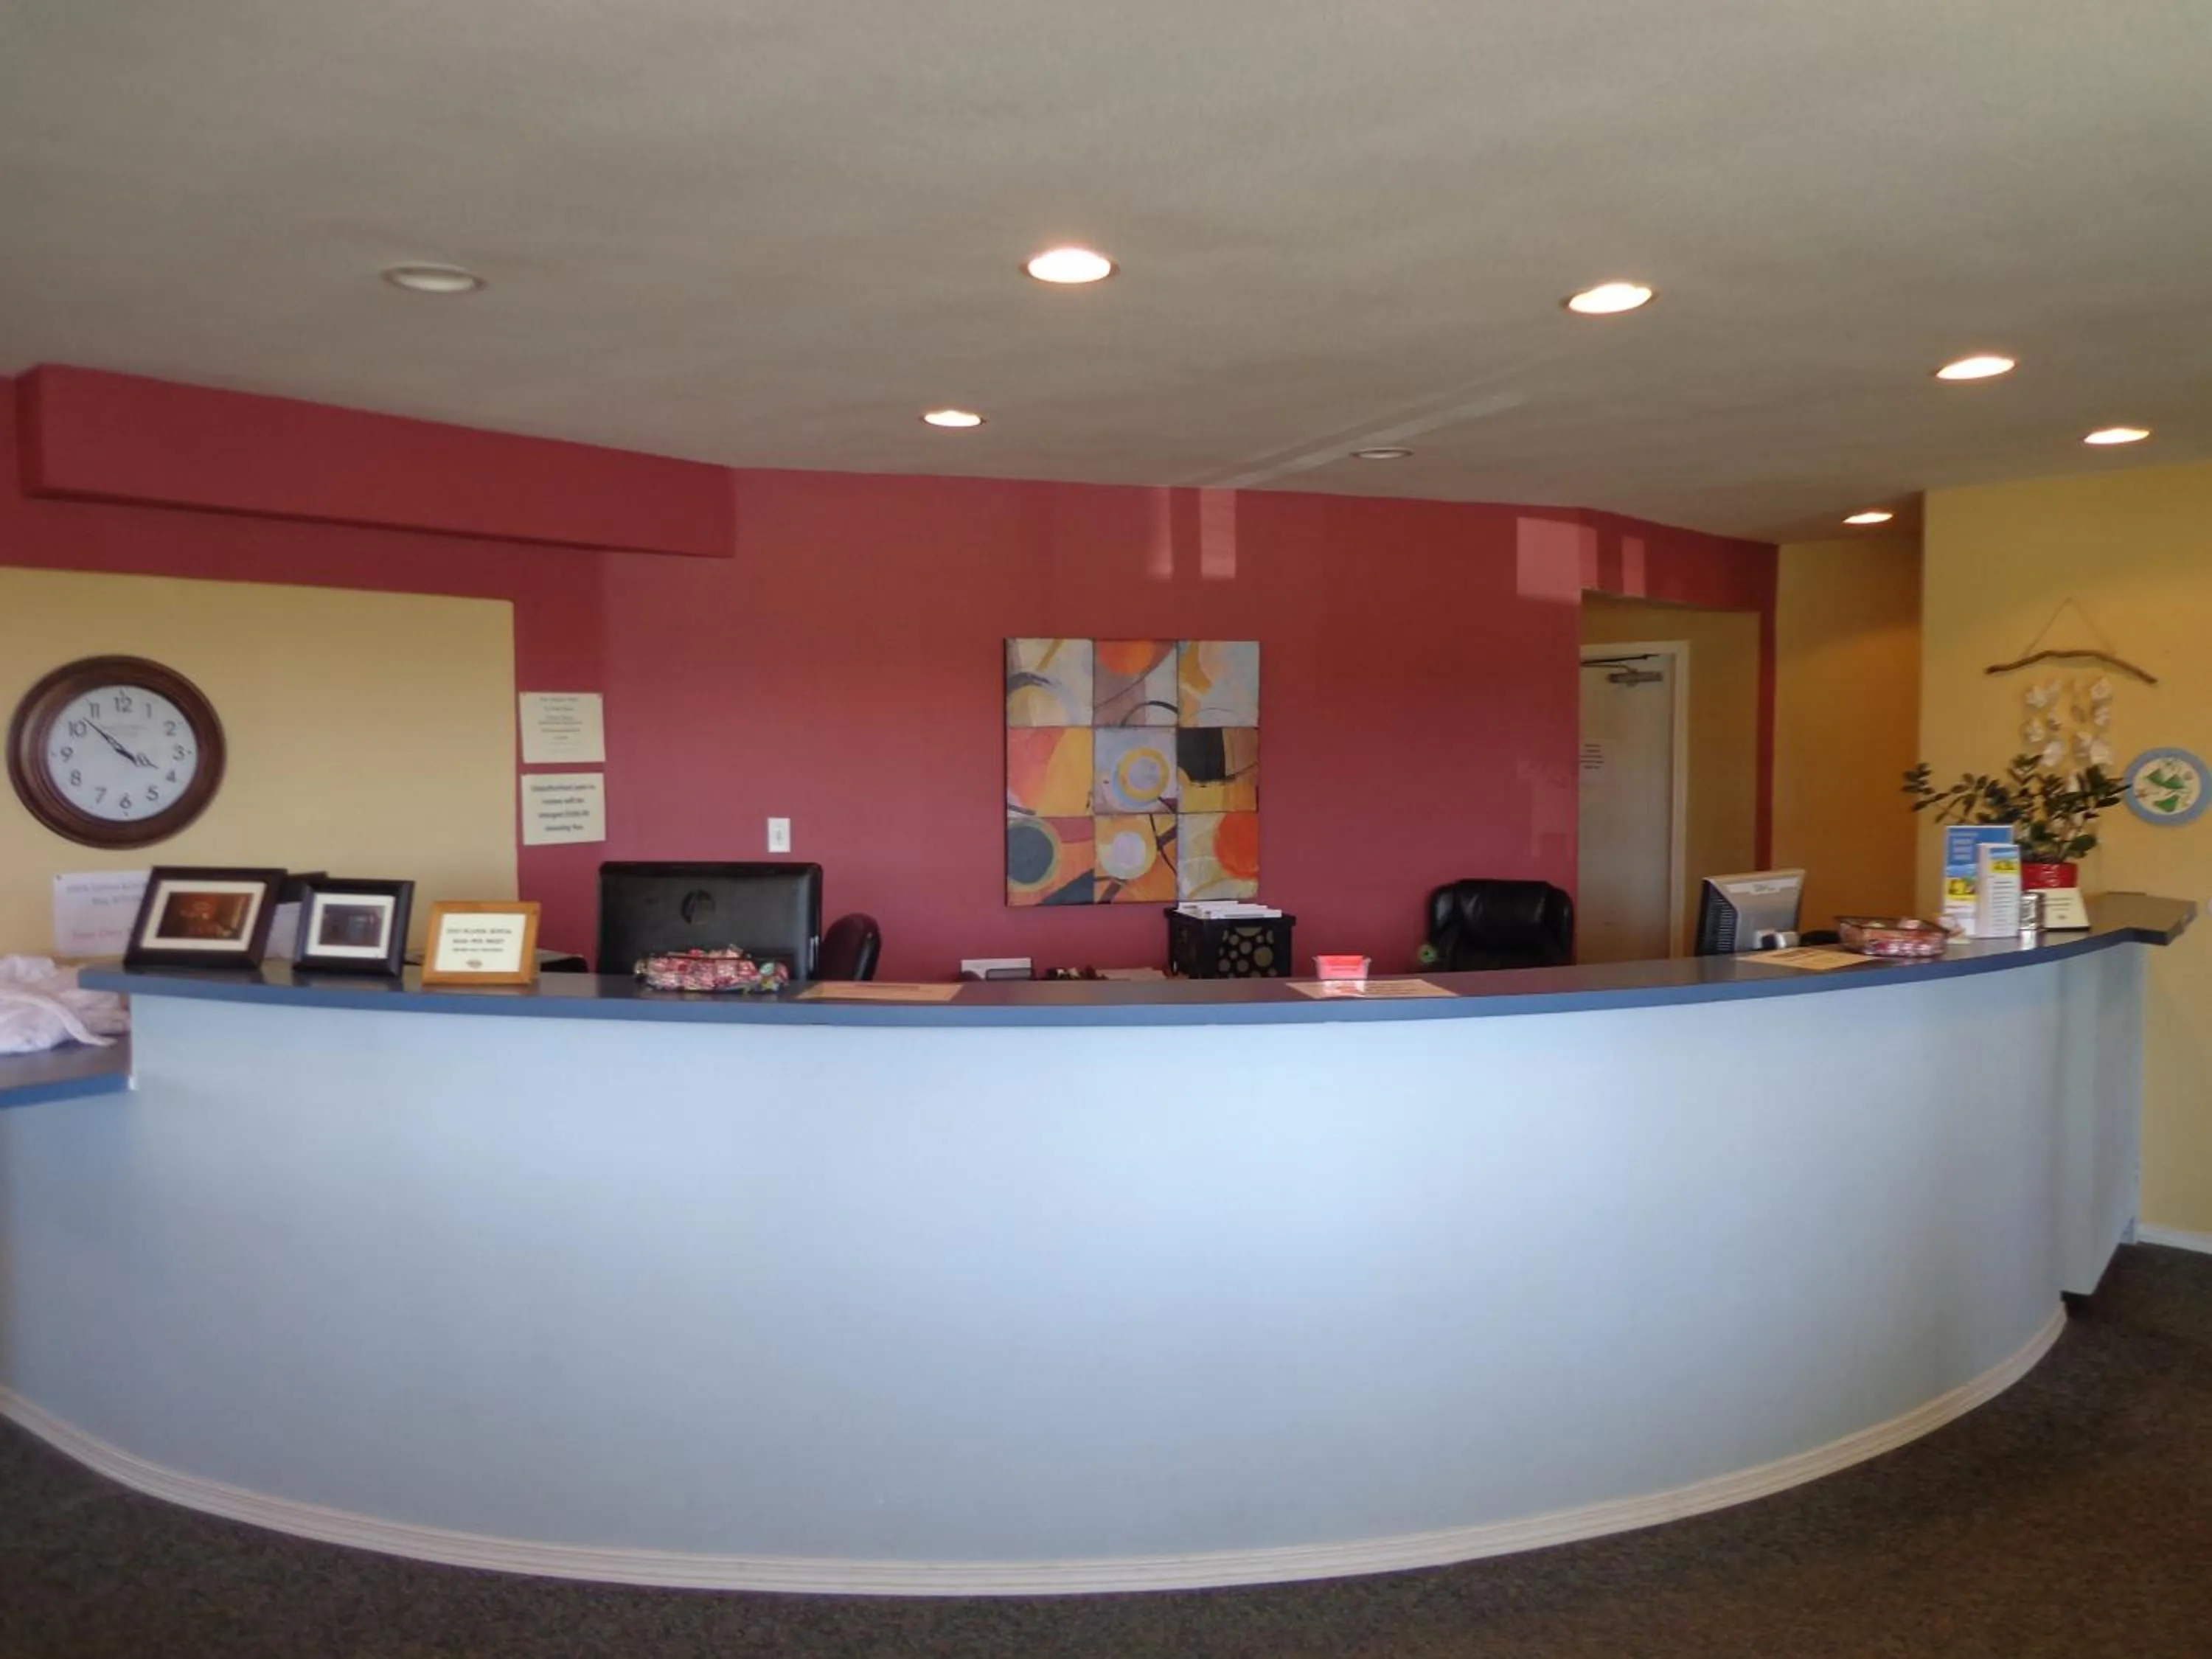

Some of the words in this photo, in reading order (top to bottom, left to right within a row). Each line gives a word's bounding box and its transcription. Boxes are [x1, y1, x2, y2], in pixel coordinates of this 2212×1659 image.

[89, 703, 100, 719] 11
[114, 696, 133, 713] 12
[146, 703, 152, 718] 1
[68, 721, 87, 737] 10
[163, 720, 176, 737] 2
[60, 747, 73, 762] 9
[173, 745, 185, 760] 3
[70, 769, 81, 786] 8
[166, 770, 176, 782] 4
[95, 787, 106, 804] 7
[119, 793, 132, 809] 6
[146, 786, 159, 801] 5
